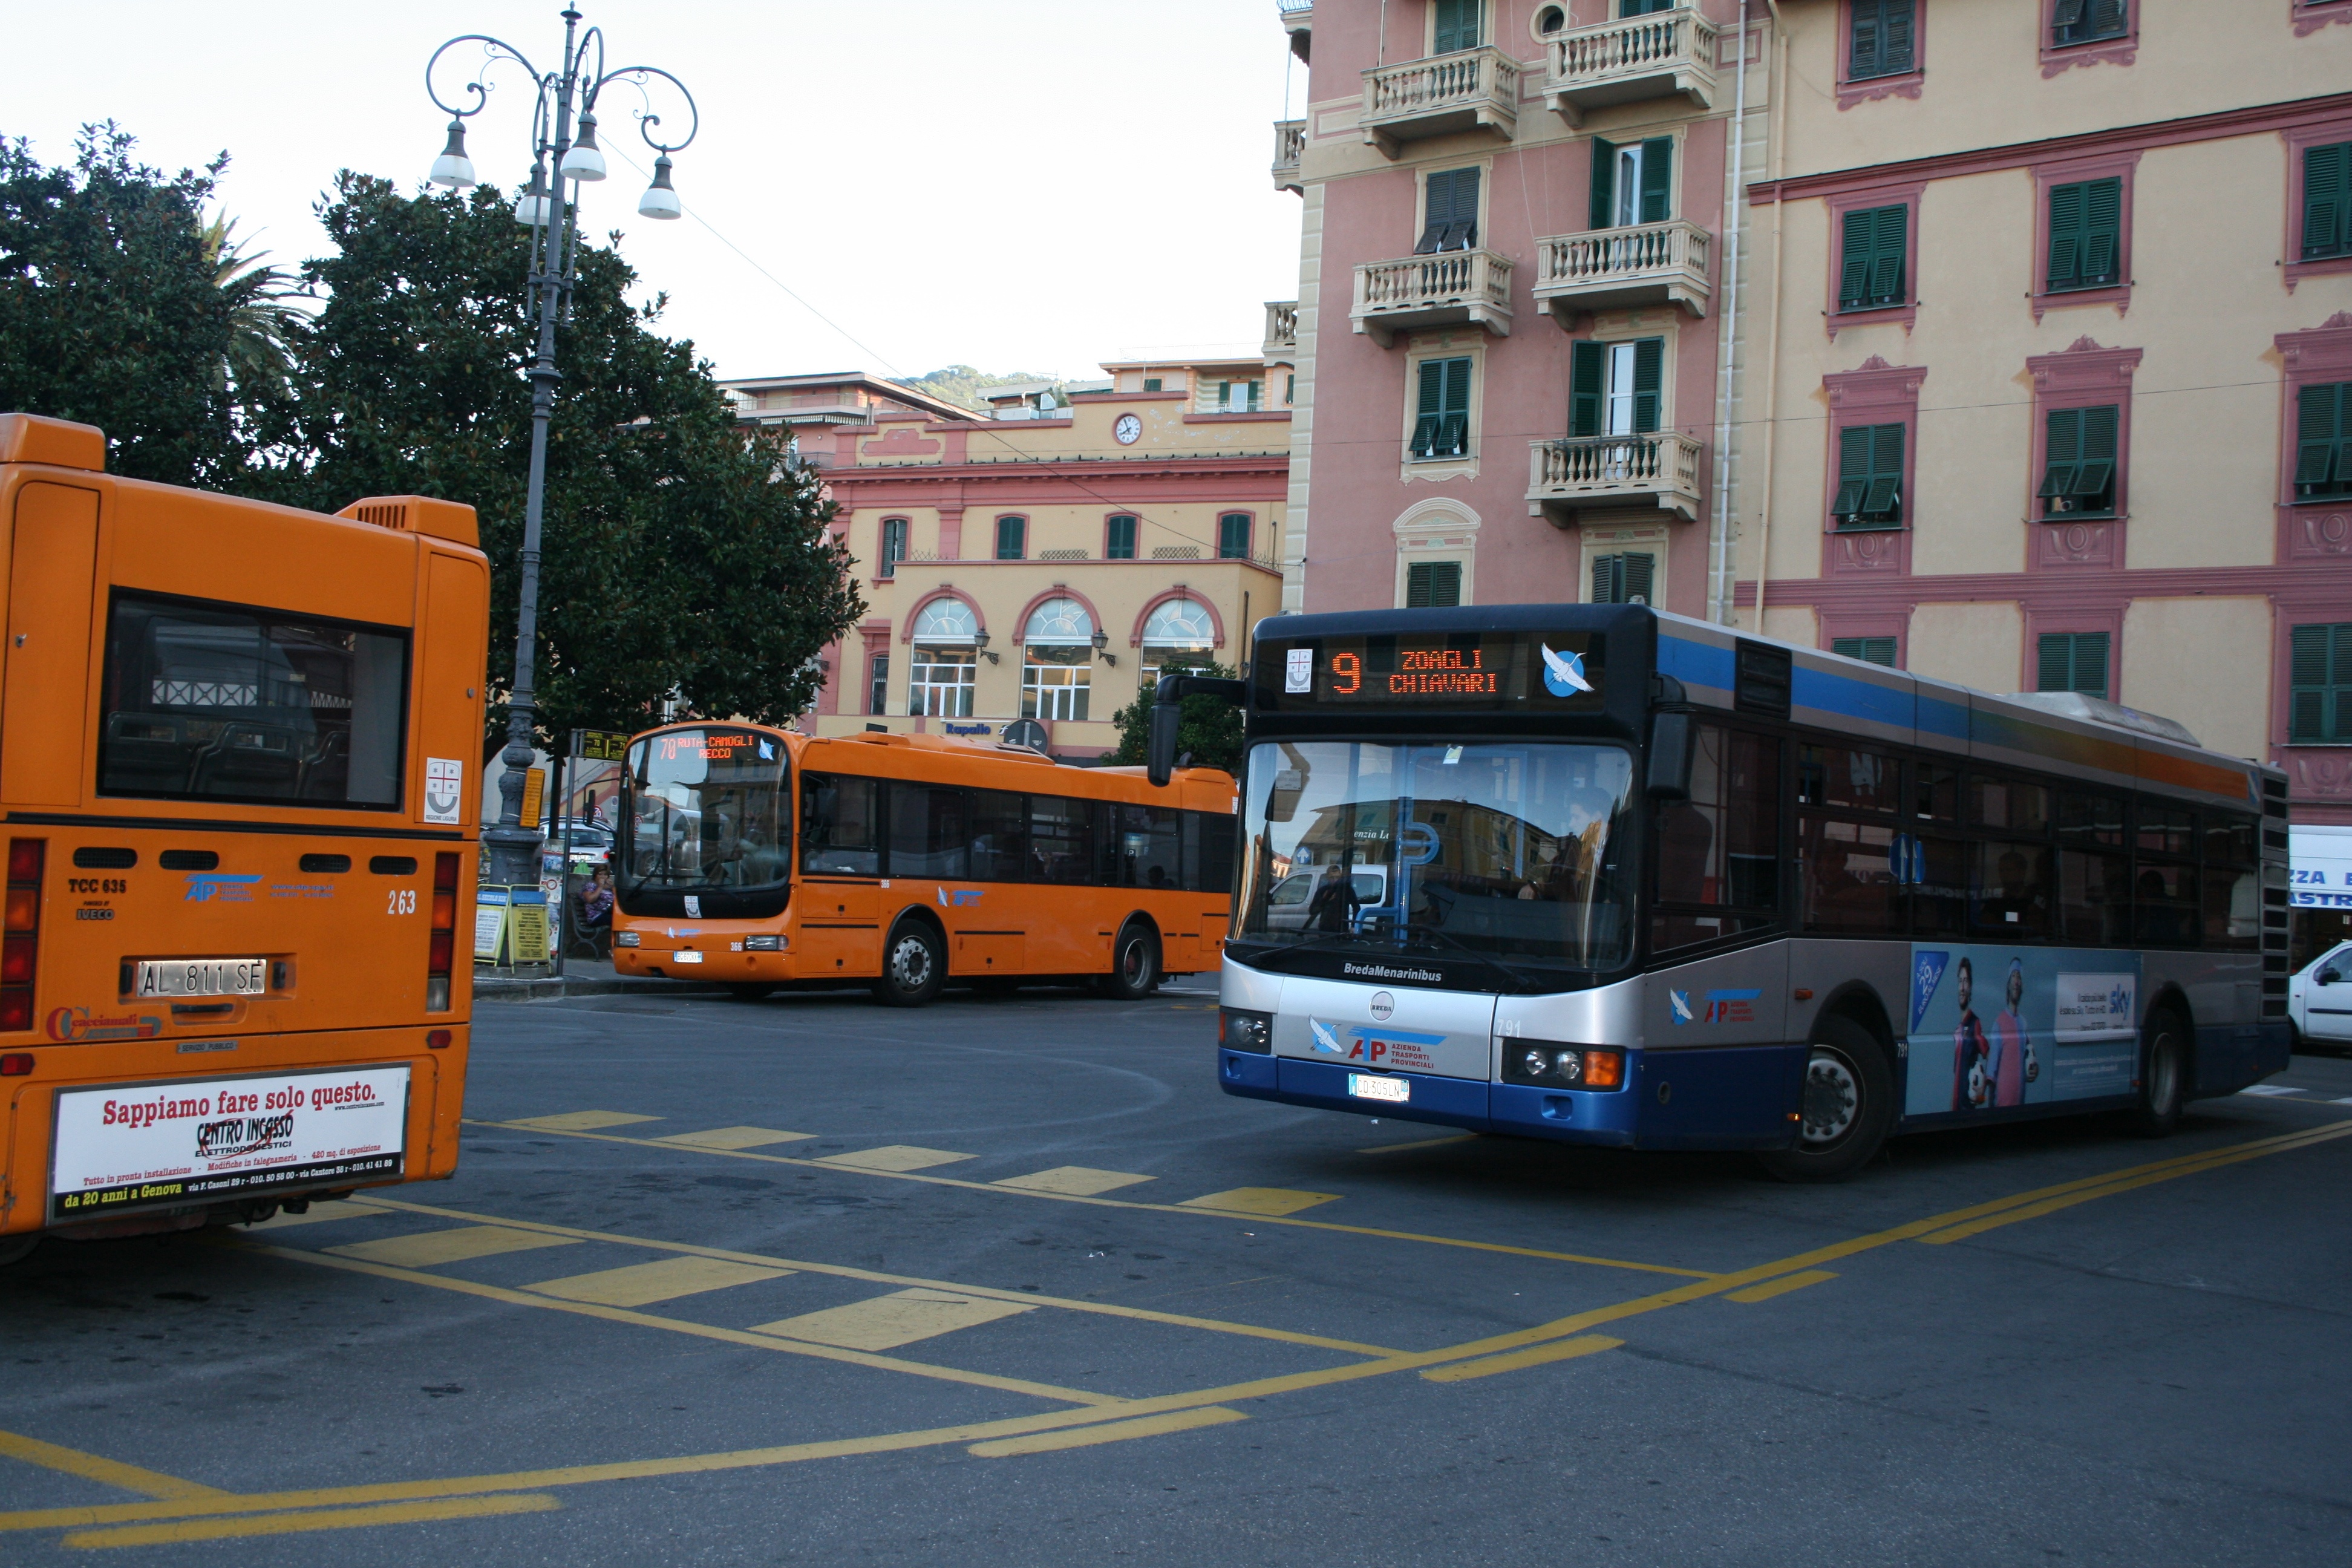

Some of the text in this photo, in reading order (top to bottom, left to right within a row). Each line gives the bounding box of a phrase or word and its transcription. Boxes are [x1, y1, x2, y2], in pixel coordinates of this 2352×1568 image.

[1402, 650, 1481, 670] ZOAGLI
[1333, 652, 1360, 693] 9
[1390, 673, 1497, 693] CHIAVARI
[946, 723, 991, 736] Rapallo
[660, 735, 754, 760] 70 RUTA-CAMOGLI
[699, 748, 733, 759] RECCO
[1354, 829, 1377, 838] enzia
[68, 878, 127, 893] TCC 635
[387, 890, 416, 915] 263
[76, 909, 115, 920] IVECO
[730, 942, 742, 952] 366
[144, 965, 169, 993] AL
[186, 965, 223, 991] 811
[1344, 962, 1442, 982] BredaMenarinibus
[1919, 965, 1932, 995] 29
[2110, 984, 2131, 1021] sky
[72, 1013, 137, 1027] cacciamali
[1497, 1018, 1521, 1037] 791
[1391, 1044, 1421, 1052] AZIENDA
[1391, 1051, 1429, 1060] TRASPORTI
[1898, 1043, 1908, 1057] 791
[1391, 1058, 1434, 1068] PROVINCIALI
[103, 1081, 376, 1129] Sappiamo fare solo questo.
[197, 1114, 294, 1146] CENTRO INCASSO
[194, 1140, 292, 1158] ELETTRODOMESTICI
[83, 1176, 105, 1186] Tutto
[106, 1174, 115, 1184] in
[116, 1172, 142, 1185] pronta
[144, 1166, 192, 1178] installazione
[207, 1159, 243, 1171] Modifiche
[244, 1157, 251, 1167] in
[253, 1154, 298, 1166] falegnameria
[312, 1150, 325, 1159] 420
[347, 1144, 381, 1155] esposizione
[188, 1182, 199, 1192] via
[207, 1178, 230, 1189] Casoni
[230, 1178, 240, 1186] 29
[299, 1169, 309, 1178] via
[310, 1168, 335, 1177] Cantore
[384, 1159, 393, 1168] 89
[65, 1183, 181, 1208] da 20 anni a Genova
